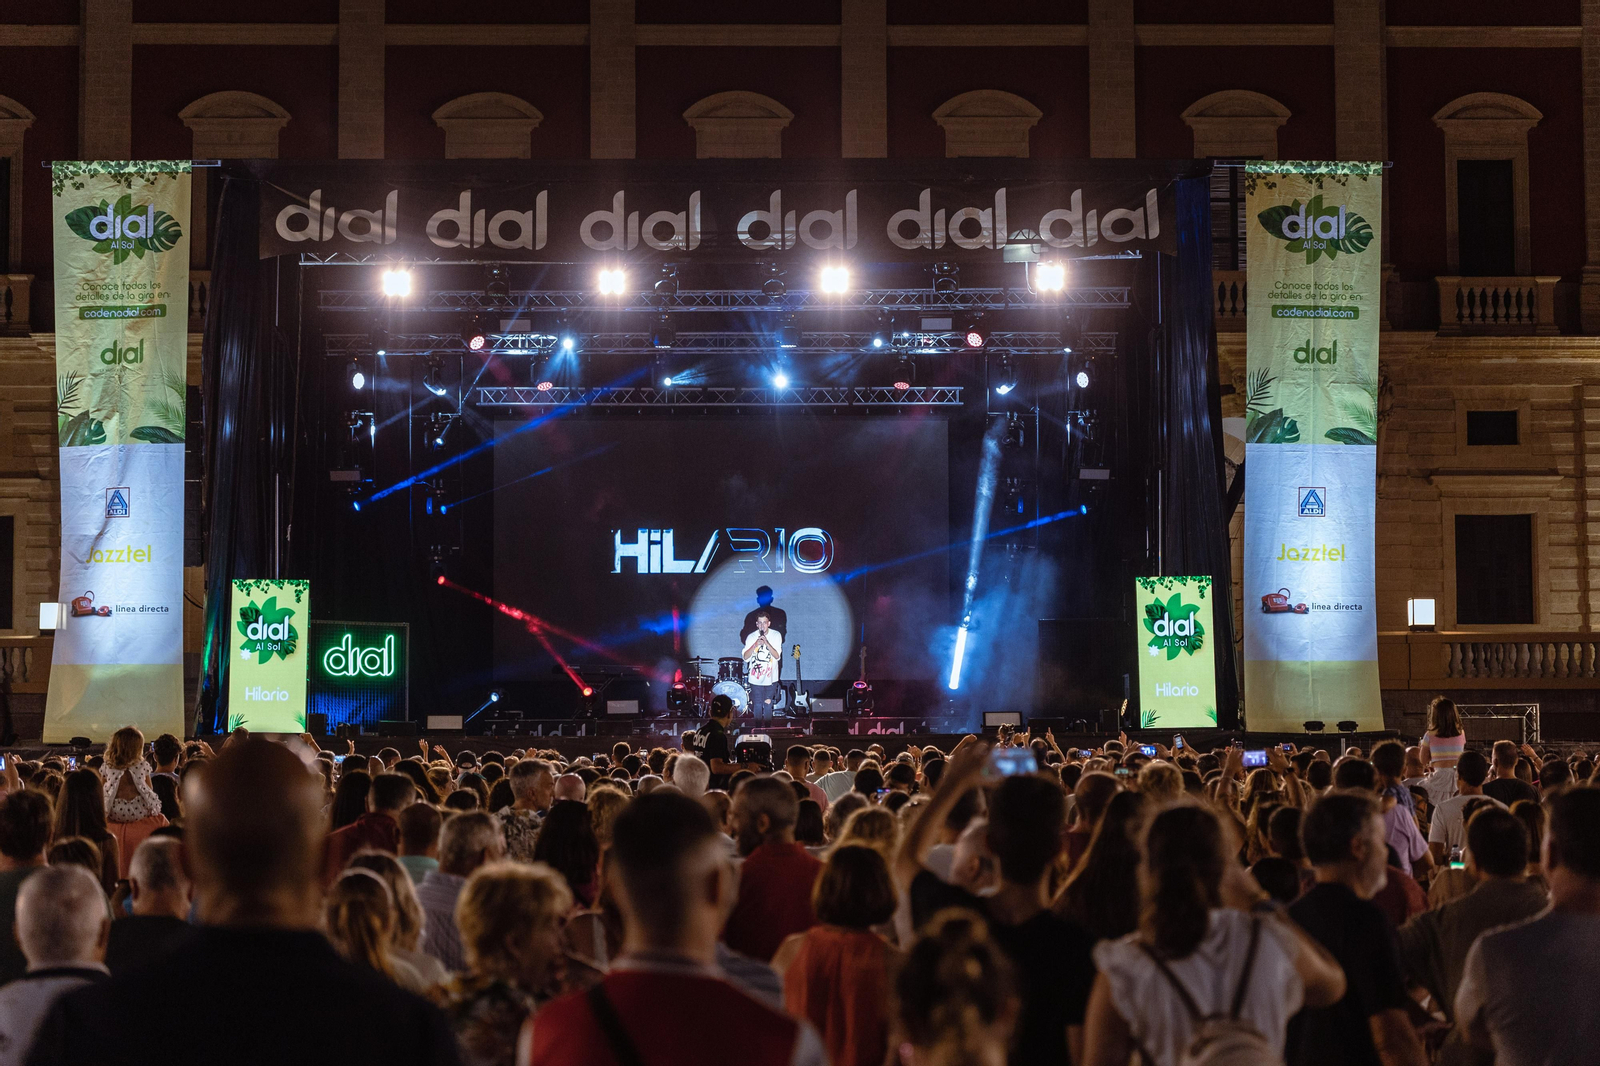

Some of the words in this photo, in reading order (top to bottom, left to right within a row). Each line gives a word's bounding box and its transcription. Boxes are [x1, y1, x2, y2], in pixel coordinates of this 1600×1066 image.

[89, 203, 154, 240] dial
[275, 189, 398, 245] dial
[425, 189, 548, 250] dial
[579, 189, 701, 251] dial
[736, 189, 858, 251] dial
[886, 187, 1007, 250] dial
[1039, 188, 1160, 248] dial
[1281, 204, 1346, 240] dial
[110, 241, 119, 250] Al
[121, 241, 135, 250] Sol
[1302, 241, 1311, 250] Al
[1312, 241, 1327, 250] Sol
[82, 282, 119, 291] Conoce
[121, 281, 147, 290] todos
[149, 280, 162, 290] los
[1274, 281, 1312, 290] Conoce
[1314, 281, 1339, 290] todos
[1341, 282, 1354, 291] los
[75, 292, 110, 301] detalles
[112, 291, 125, 300] de
[126, 291, 136, 300] la
[137, 291, 155, 302] gira
[1267, 290, 1303, 300] detalles
[1304, 291, 1317, 300] de
[1319, 291, 1328, 300] la
[1330, 292, 1347, 303] gira
[84, 306, 162, 318] cadenadial.com
[1276, 307, 1354, 318] cadenadial.com
[100, 338, 144, 366] dial
[1293, 338, 1338, 365] dial
[86, 544, 152, 564] Jazztel
[1276, 543, 1345, 562] Jazztel
[138, 604, 169, 613] directa
[1333, 602, 1363, 611] directa
[246, 615, 290, 641] dial
[1153, 611, 1195, 637] dial
[255, 642, 264, 651] Al
[267, 642, 281, 651] Sol
[1163, 638, 1171, 647] Al
[1174, 638, 1188, 647] Sol
[323, 634, 395, 677] dial
[245, 686, 290, 702] Hilario
[1155, 682, 1199, 697] Hilario
